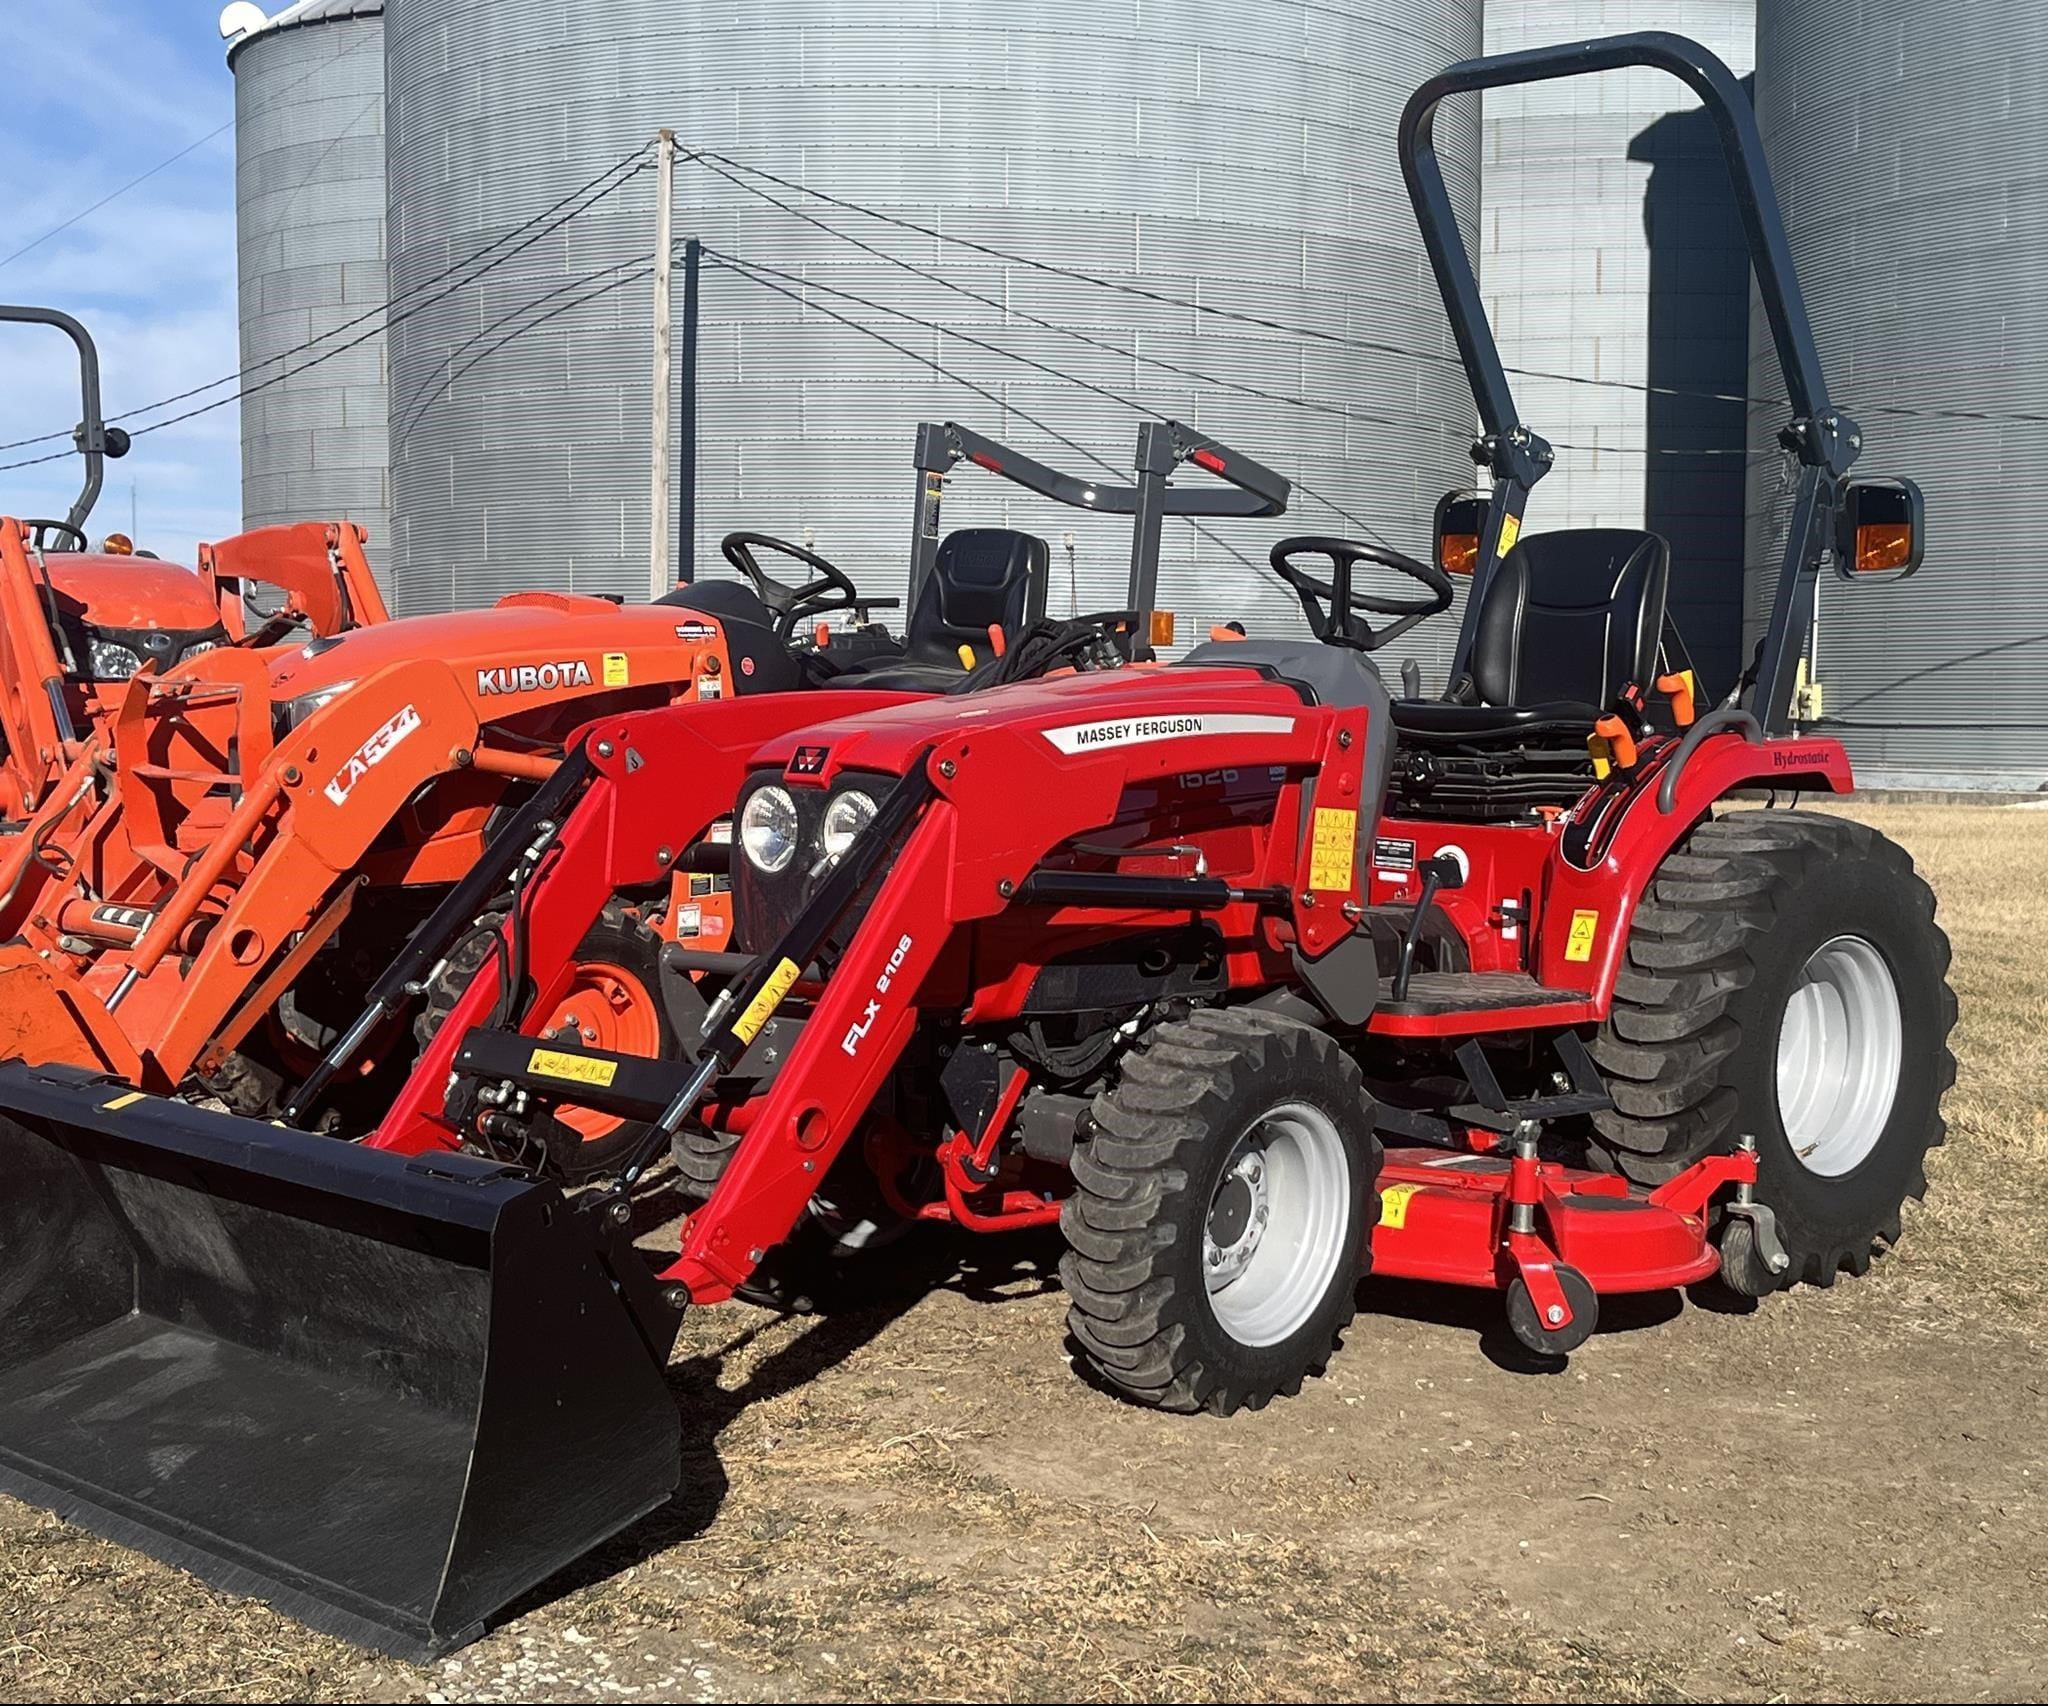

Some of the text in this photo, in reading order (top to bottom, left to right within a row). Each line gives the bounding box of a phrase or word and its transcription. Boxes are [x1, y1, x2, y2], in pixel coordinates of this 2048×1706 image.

[477, 660, 593, 696] KUBOTA
[1077, 718, 1202, 745] MASSEY FERGUSON
[324, 704, 421, 806] LA534
[1773, 750, 1830, 769] Hydrostatic
[876, 934, 912, 993] 2106
